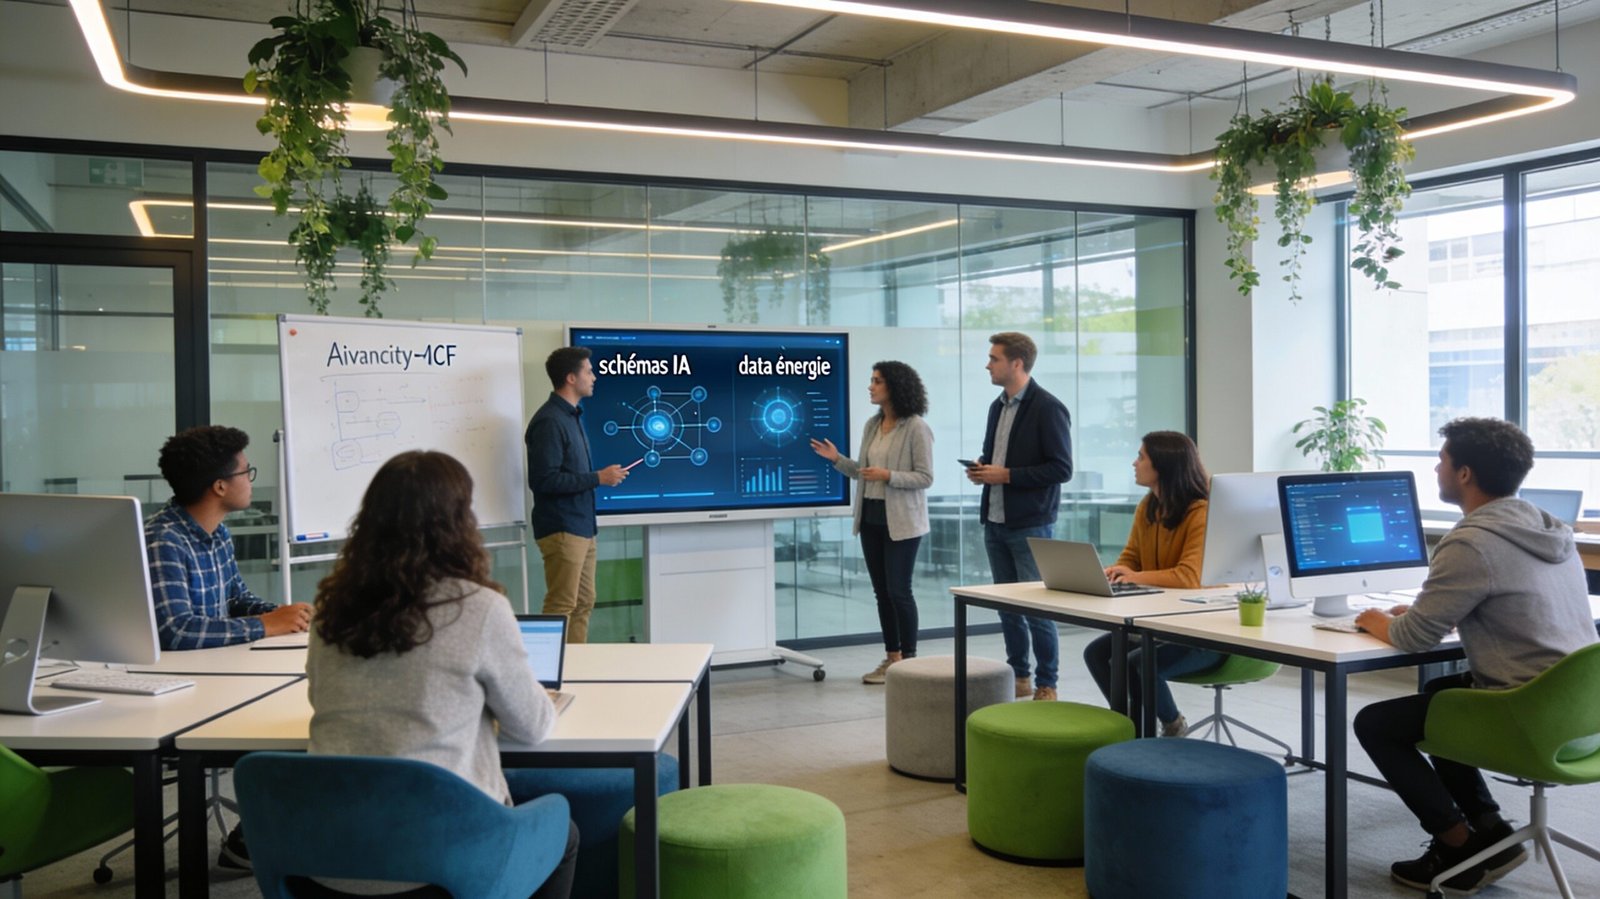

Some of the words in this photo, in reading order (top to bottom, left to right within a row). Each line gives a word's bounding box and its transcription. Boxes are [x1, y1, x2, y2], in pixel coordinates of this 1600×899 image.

[599, 353, 669, 375] schémas
[673, 354, 692, 375] IA
[738, 354, 773, 375] data
[775, 355, 831, 381] énergie
